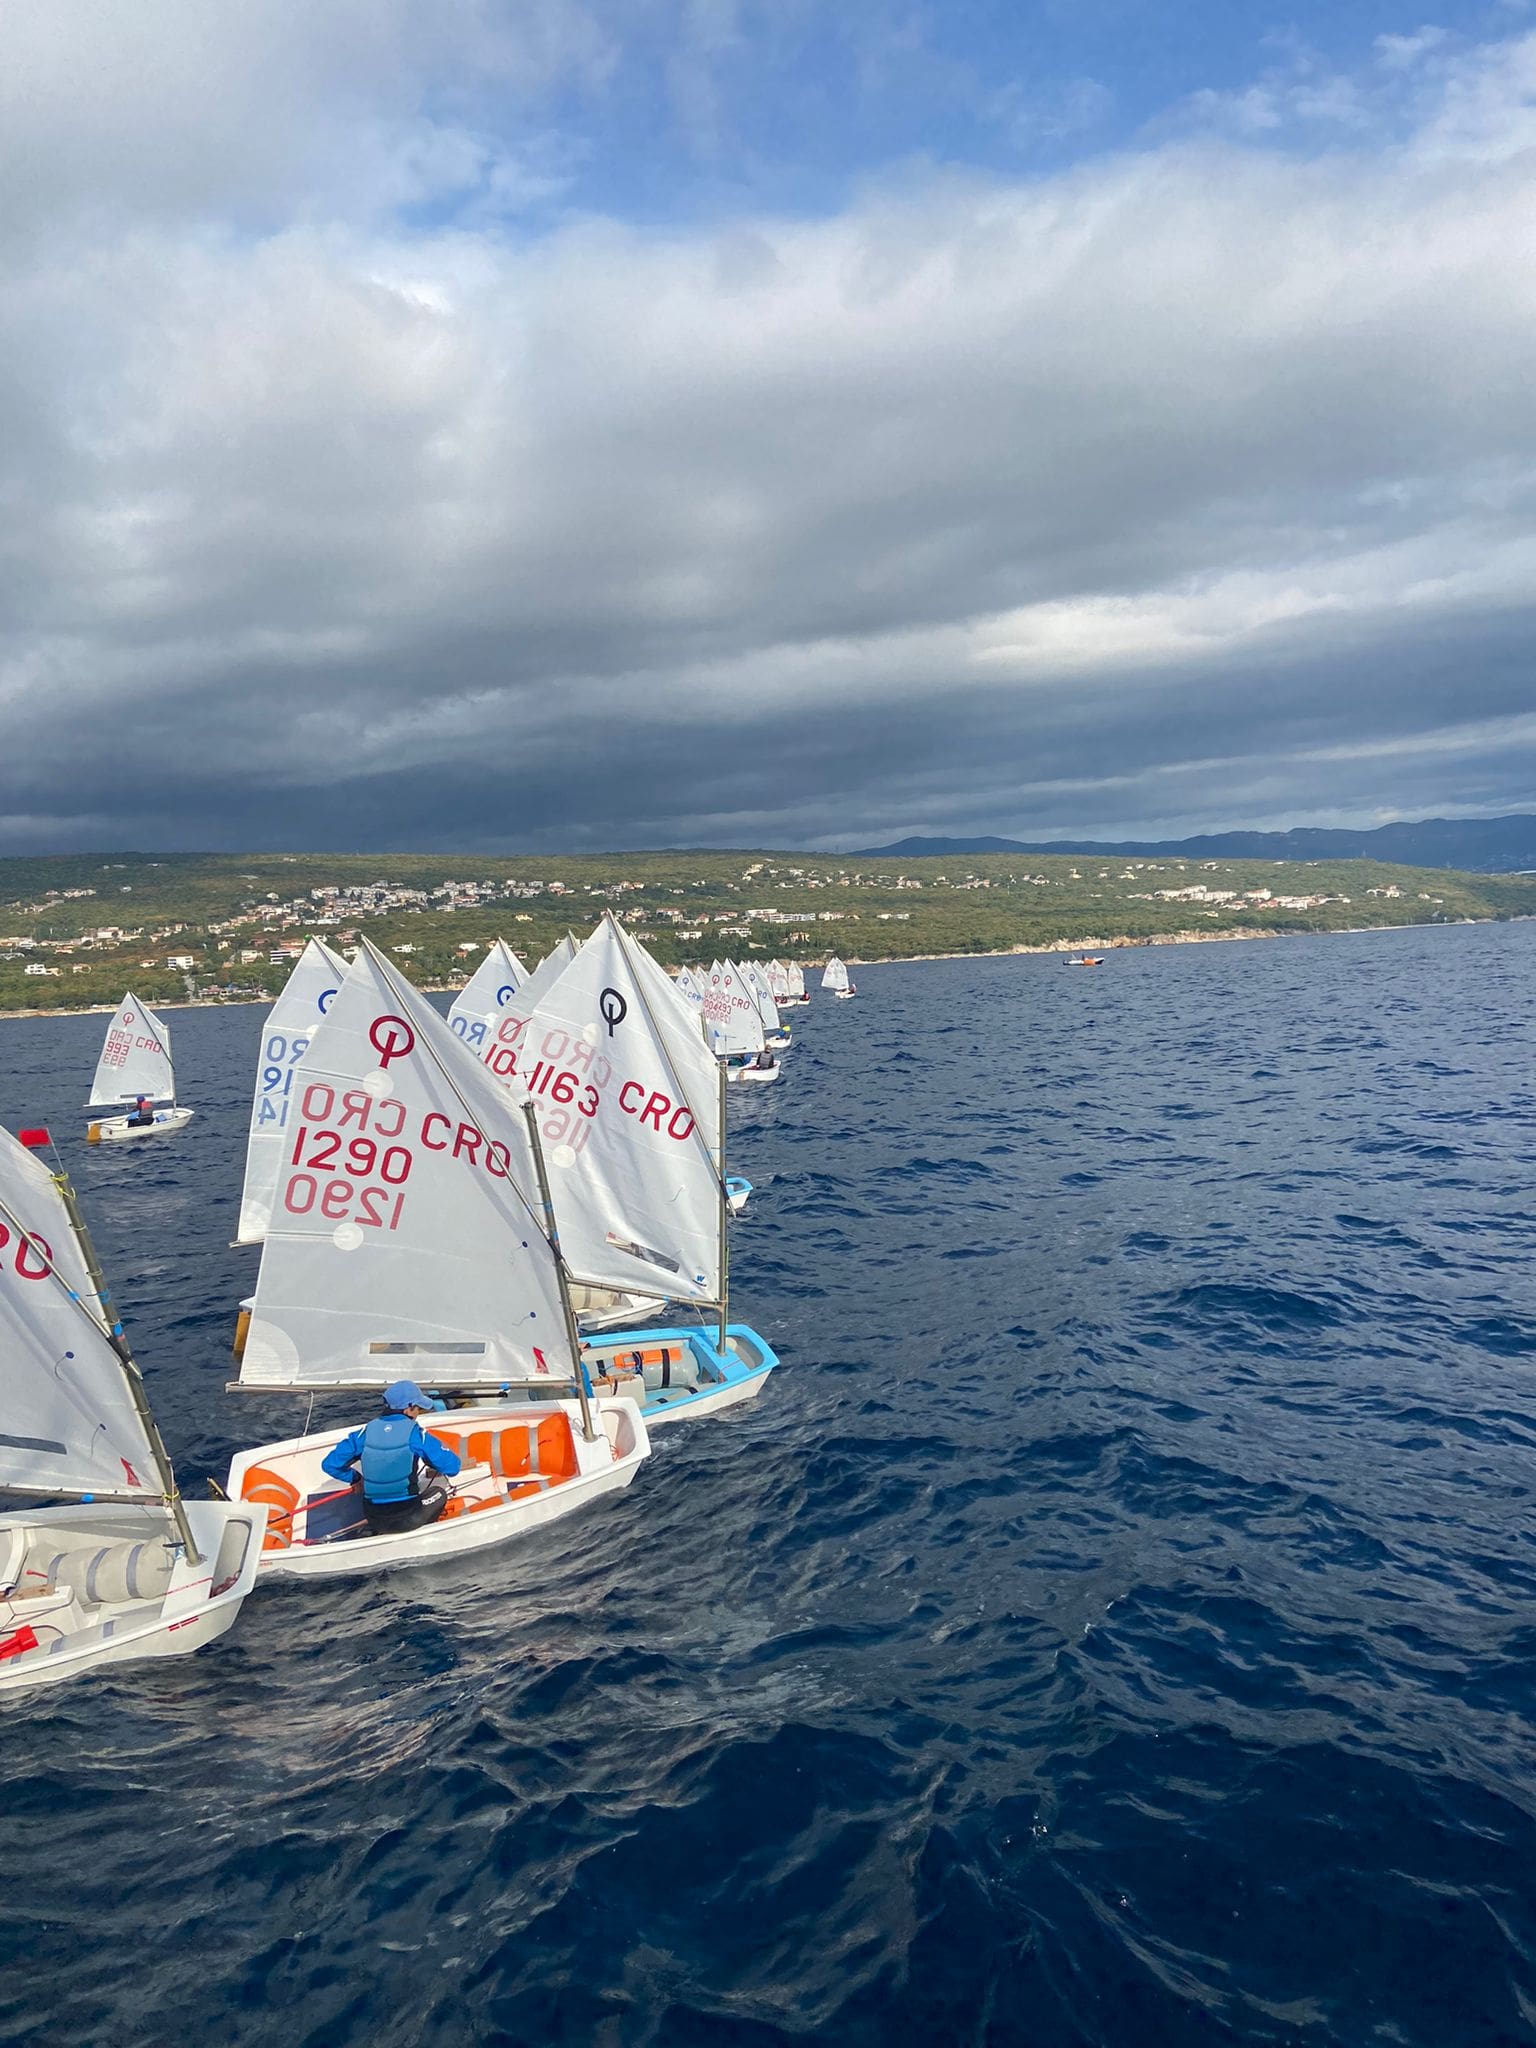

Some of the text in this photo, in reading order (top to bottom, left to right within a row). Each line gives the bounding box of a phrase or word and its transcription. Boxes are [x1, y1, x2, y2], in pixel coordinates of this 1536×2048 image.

[731, 996, 750, 1010] CRO
[106, 1041, 130, 1056] 993
[135, 1036, 163, 1053] CRO
[263, 1066, 294, 1096] 91
[528, 1060, 600, 1118] 1163
[618, 1081, 696, 1141] CRO
[291, 1126, 413, 1185] 1290
[420, 1112, 511, 1178] CRO
